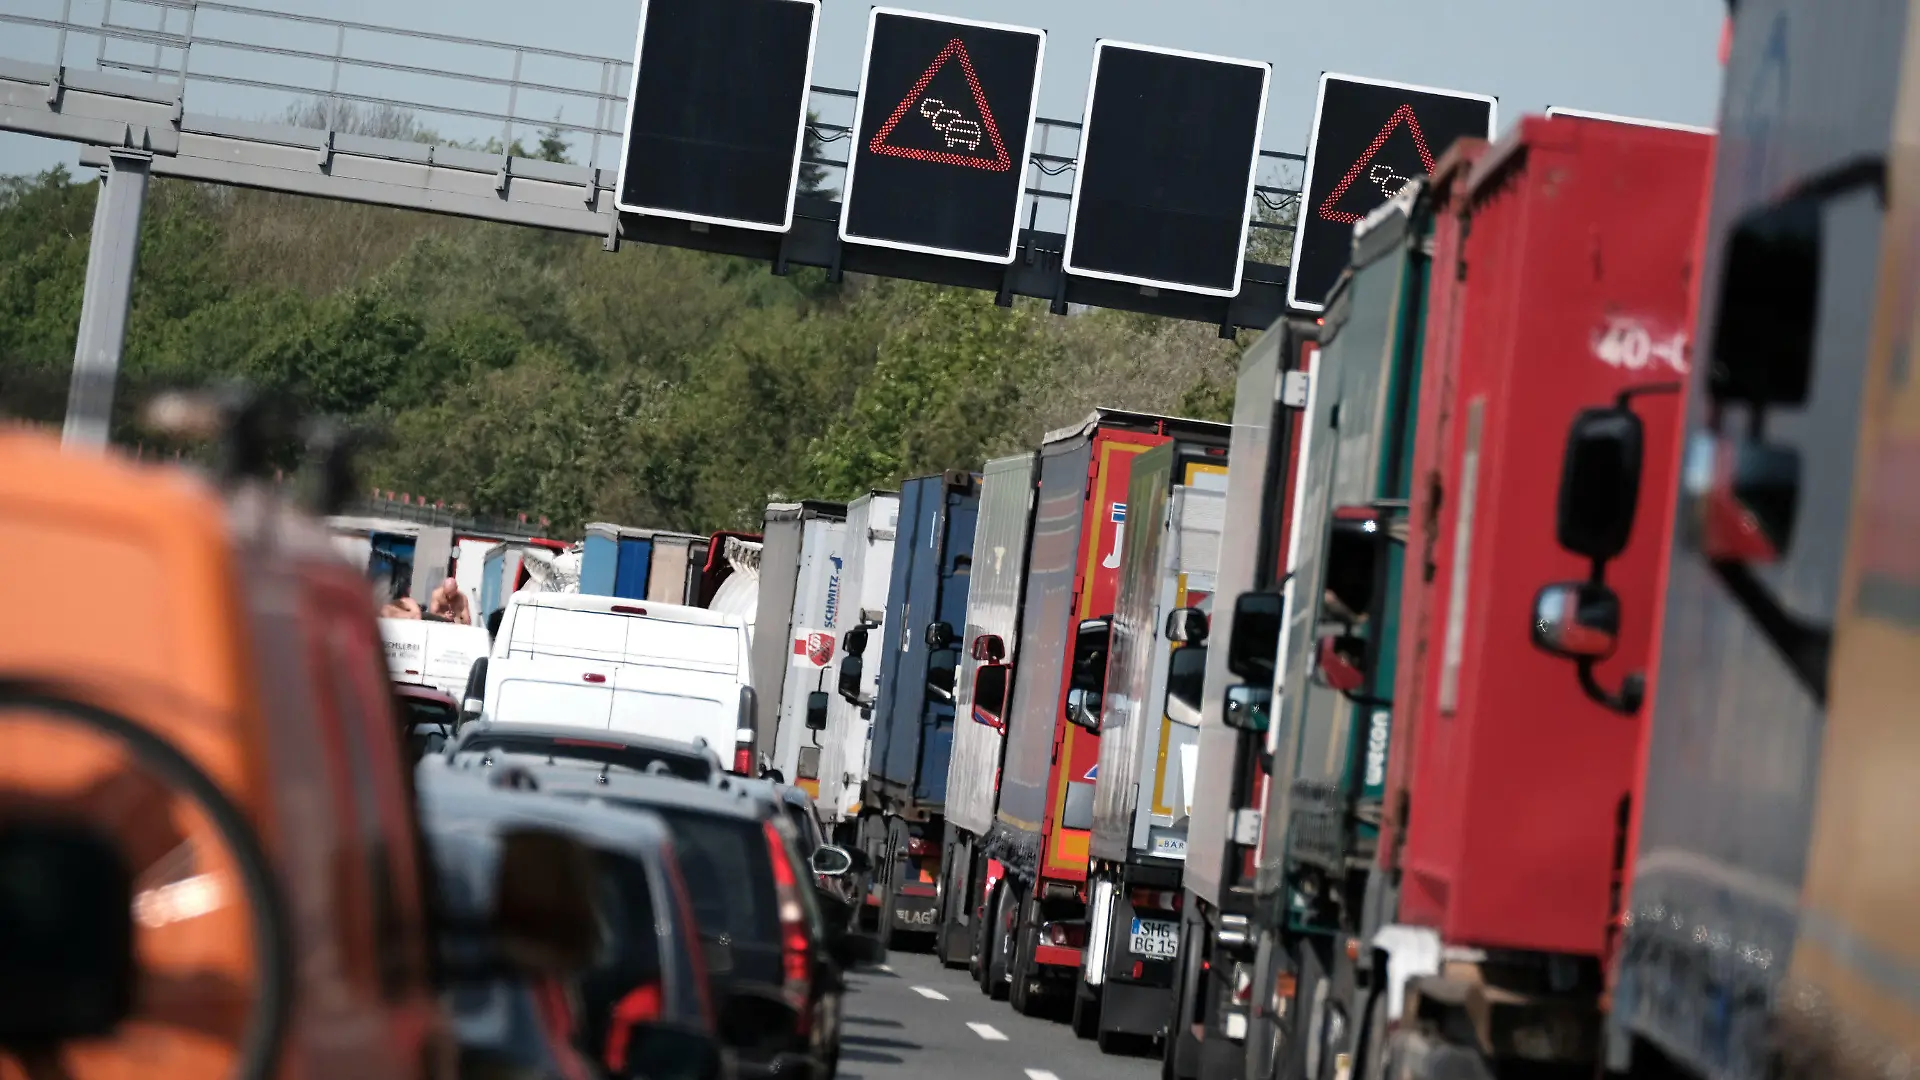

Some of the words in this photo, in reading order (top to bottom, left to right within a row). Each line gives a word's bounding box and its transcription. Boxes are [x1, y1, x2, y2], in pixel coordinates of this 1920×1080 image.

[824, 575, 839, 628] SCHMITZ
[1141, 922, 1170, 938] SHG
[1134, 937, 1154, 952] BG
[1157, 940, 1176, 954] 15
